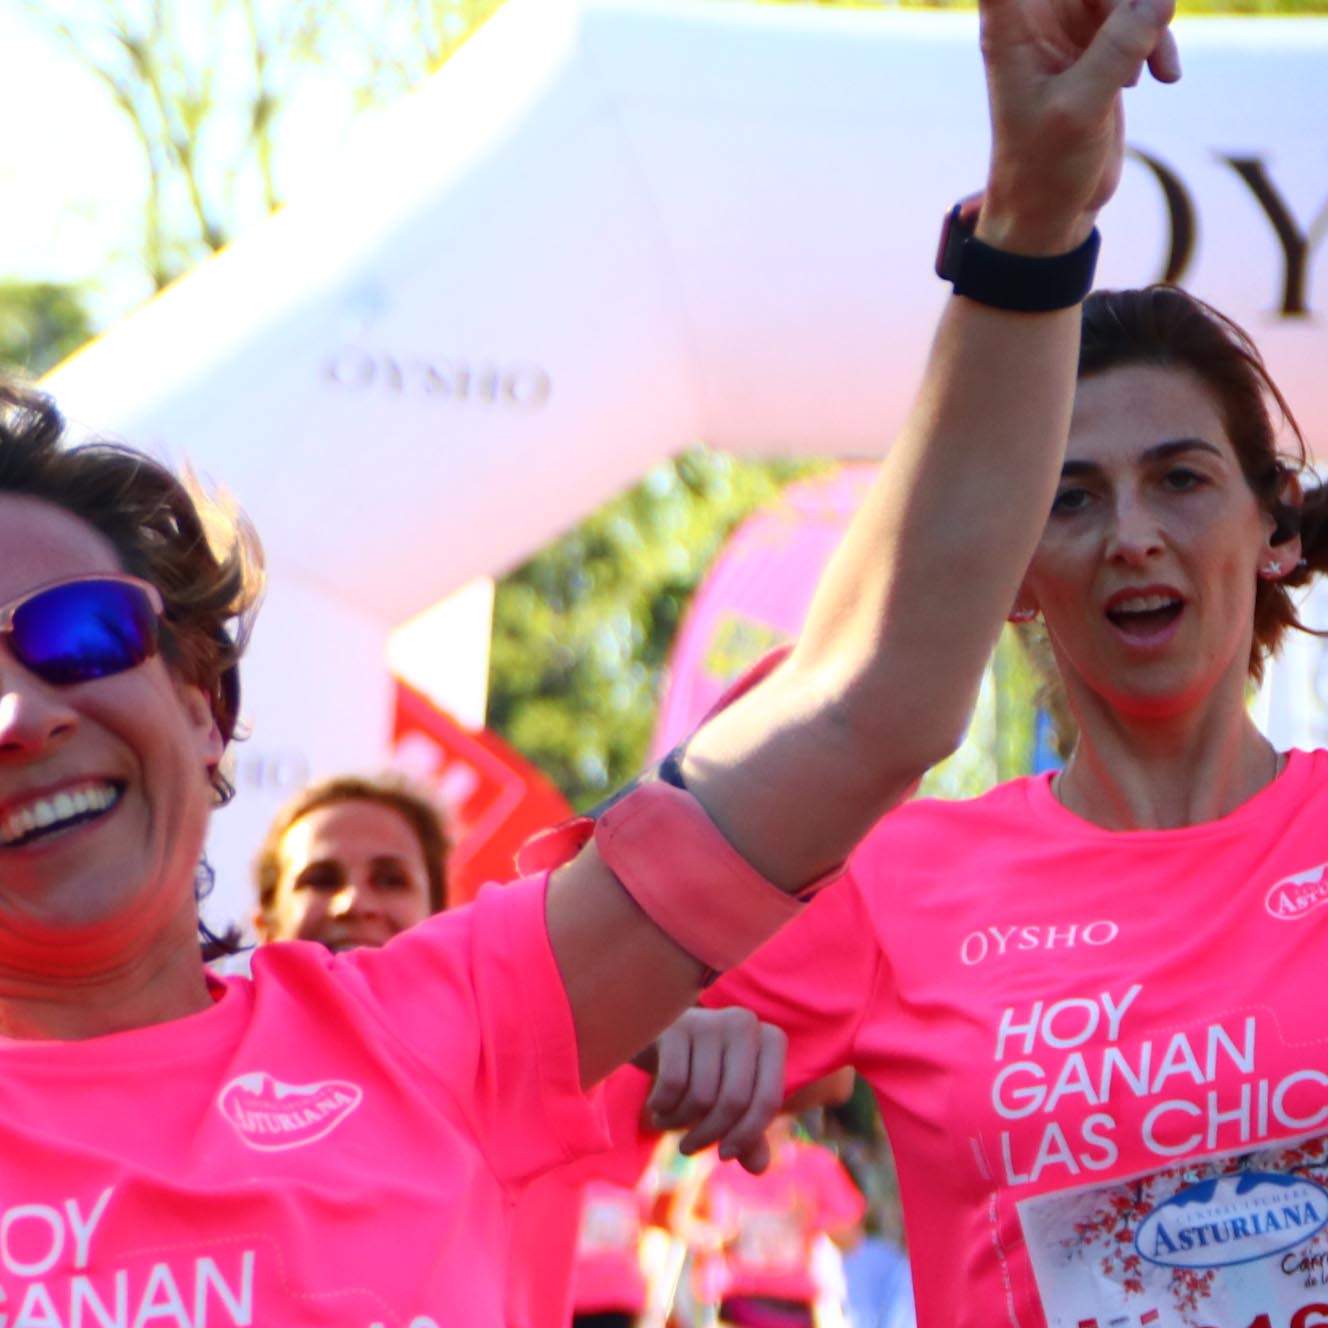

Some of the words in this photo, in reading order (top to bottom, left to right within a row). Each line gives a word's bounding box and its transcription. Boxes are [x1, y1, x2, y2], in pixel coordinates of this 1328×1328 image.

[961, 920, 1119, 965] OYSHO
[995, 984, 1143, 1061] HOY
[992, 1017, 1257, 1120] GANAN
[1001, 1113, 1118, 1186] LAS
[1142, 1069, 1328, 1157] CHIC
[1153, 1201, 1321, 1257] ASTURIANA
